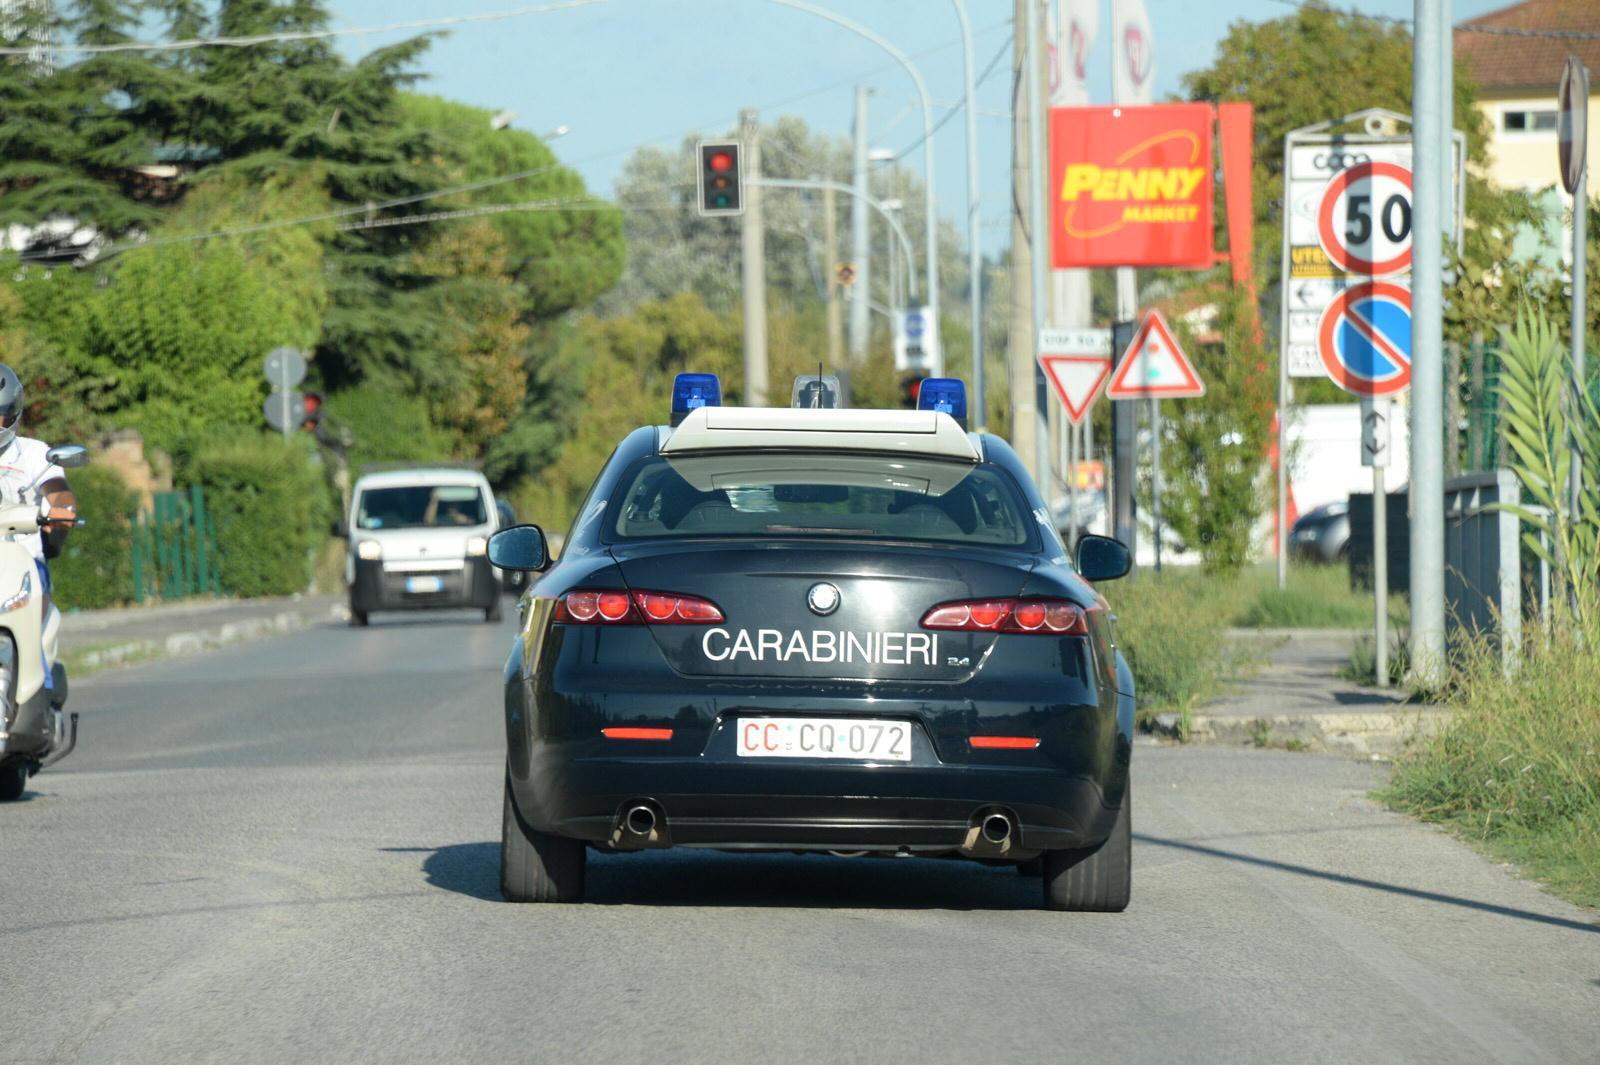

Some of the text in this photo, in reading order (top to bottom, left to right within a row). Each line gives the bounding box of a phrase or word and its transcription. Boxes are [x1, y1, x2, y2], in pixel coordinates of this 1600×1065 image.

[1061, 163, 1206, 201] PENNY
[1122, 204, 1199, 222] MARKET
[1345, 193, 1412, 245] 50
[702, 628, 938, 665] CARABINIERI
[744, 723, 904, 755] CC CQ 072
